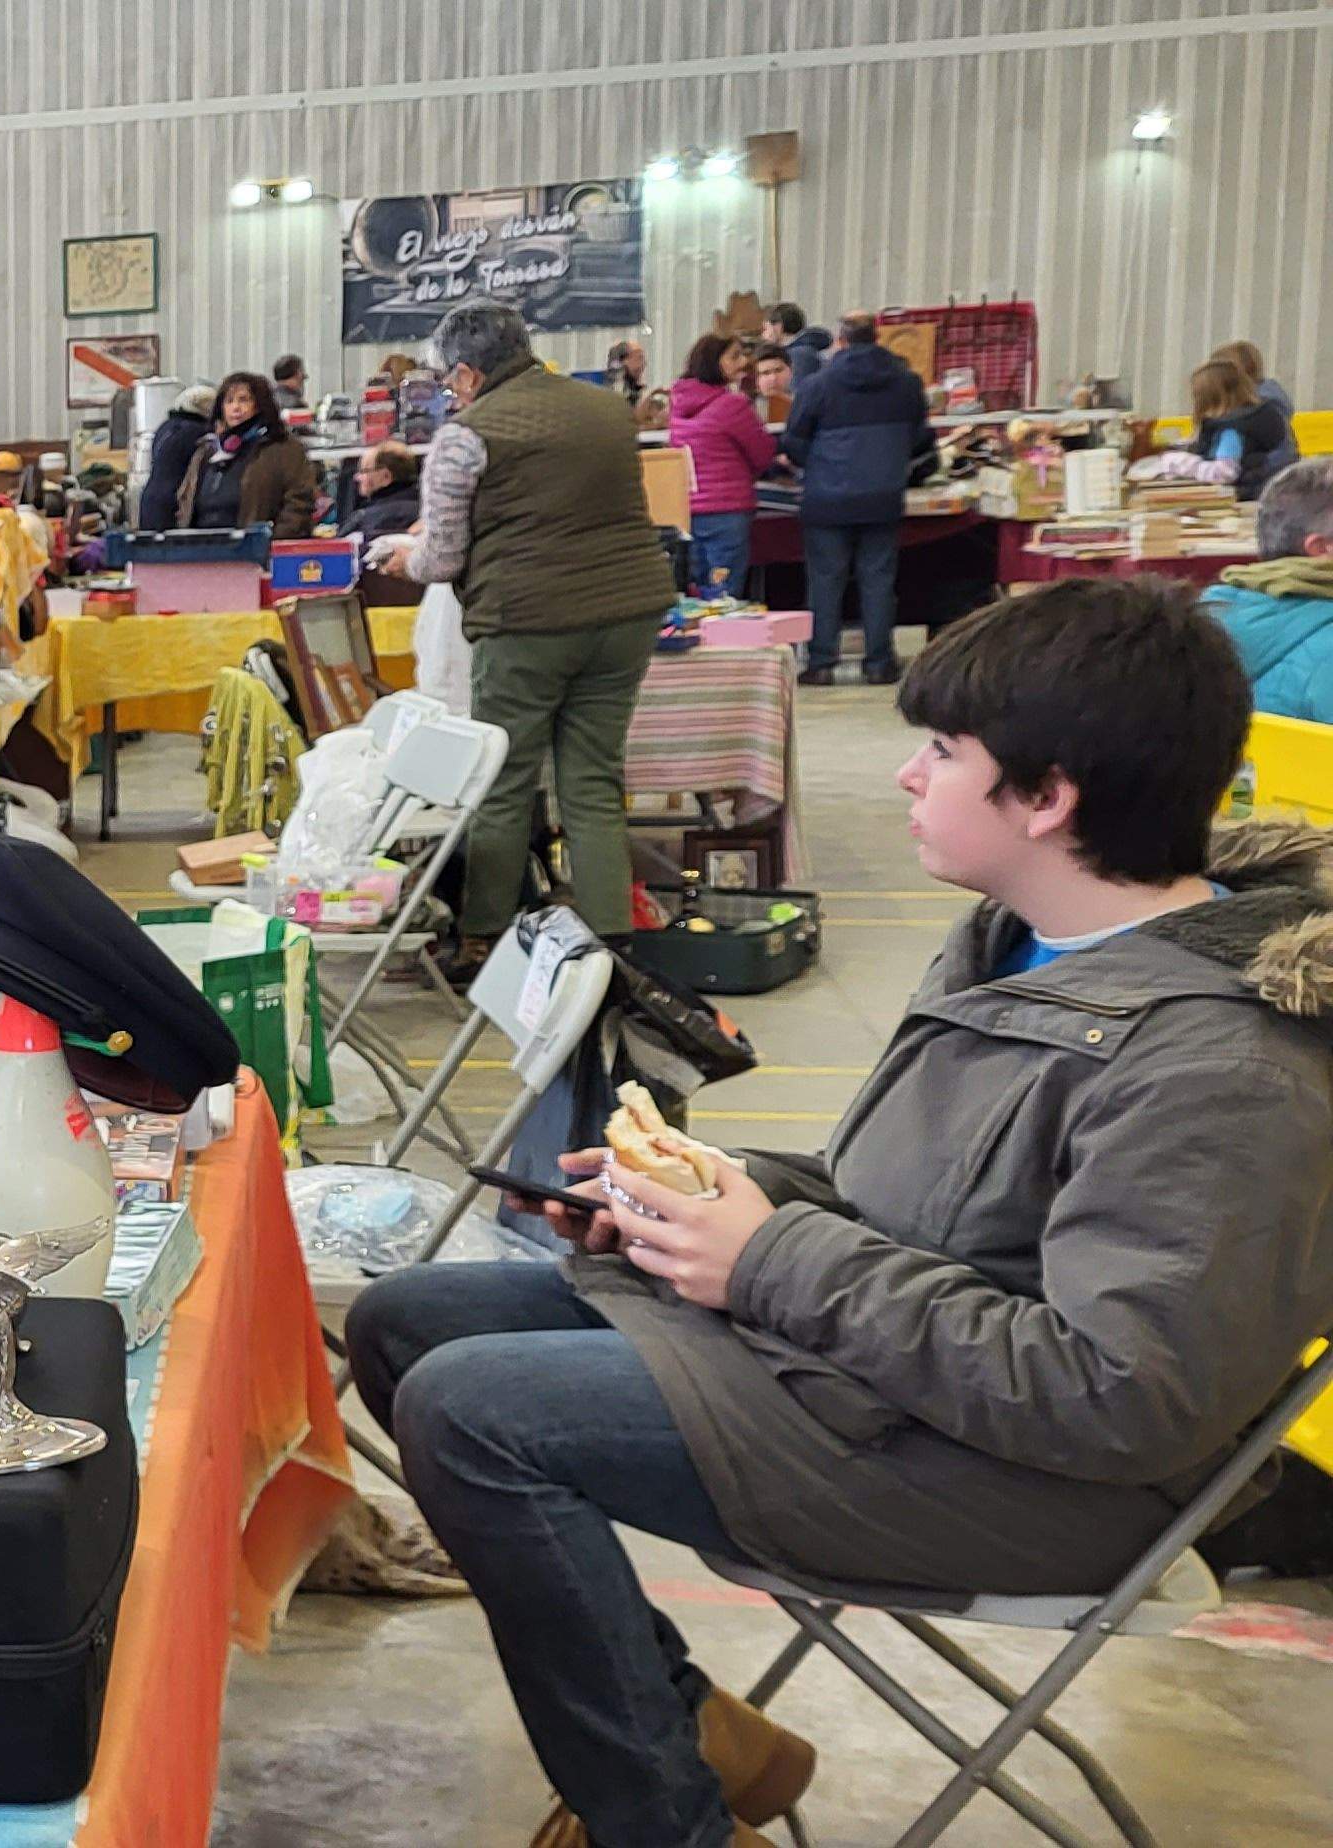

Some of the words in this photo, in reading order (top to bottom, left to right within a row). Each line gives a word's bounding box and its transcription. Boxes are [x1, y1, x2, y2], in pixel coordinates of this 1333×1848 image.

[396, 229, 423, 263] El
[416, 275, 443, 301] de
[446, 272, 471, 297] la
